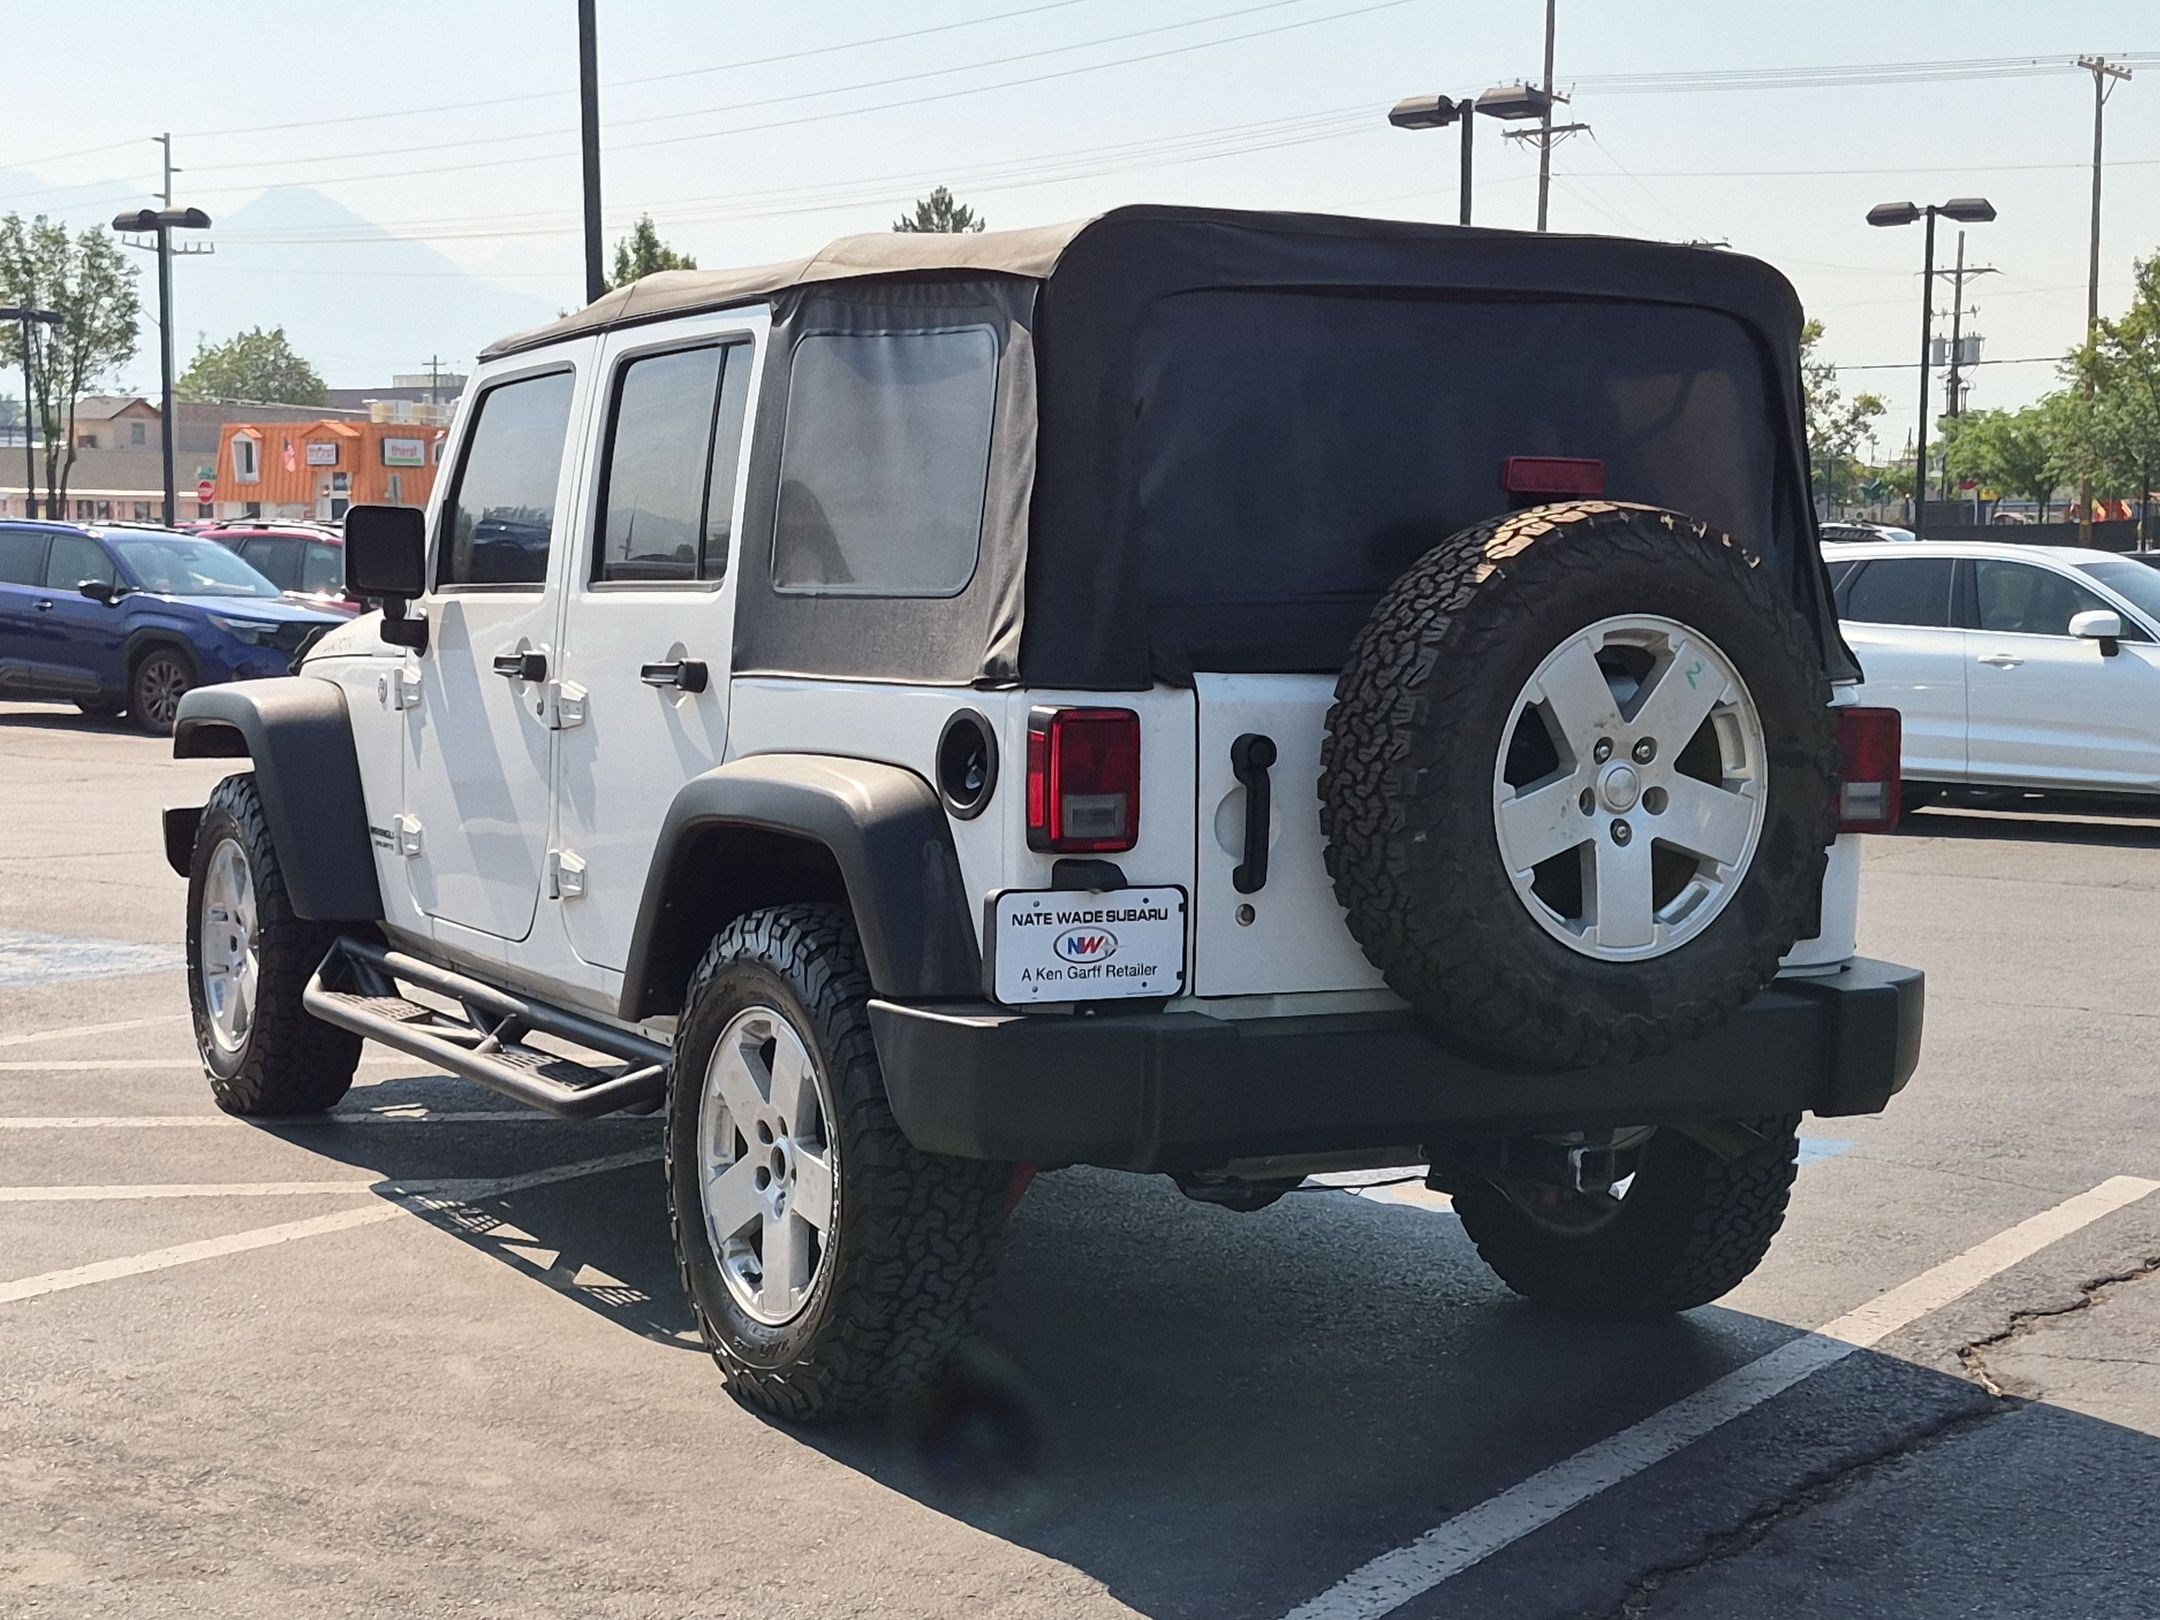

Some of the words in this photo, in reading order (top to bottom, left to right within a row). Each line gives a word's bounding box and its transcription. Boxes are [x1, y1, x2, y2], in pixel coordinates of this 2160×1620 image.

[1012, 912, 1053, 927] NATE
[1057, 910, 1105, 925] WADE
[1106, 908, 1168, 923] SUBARU
[1067, 935, 1105, 955] NW
[1021, 969, 1032, 981] A
[1036, 968, 1063, 981] Ken
[1067, 964, 1102, 980] Garff
[1106, 963, 1158, 978] Retailer
